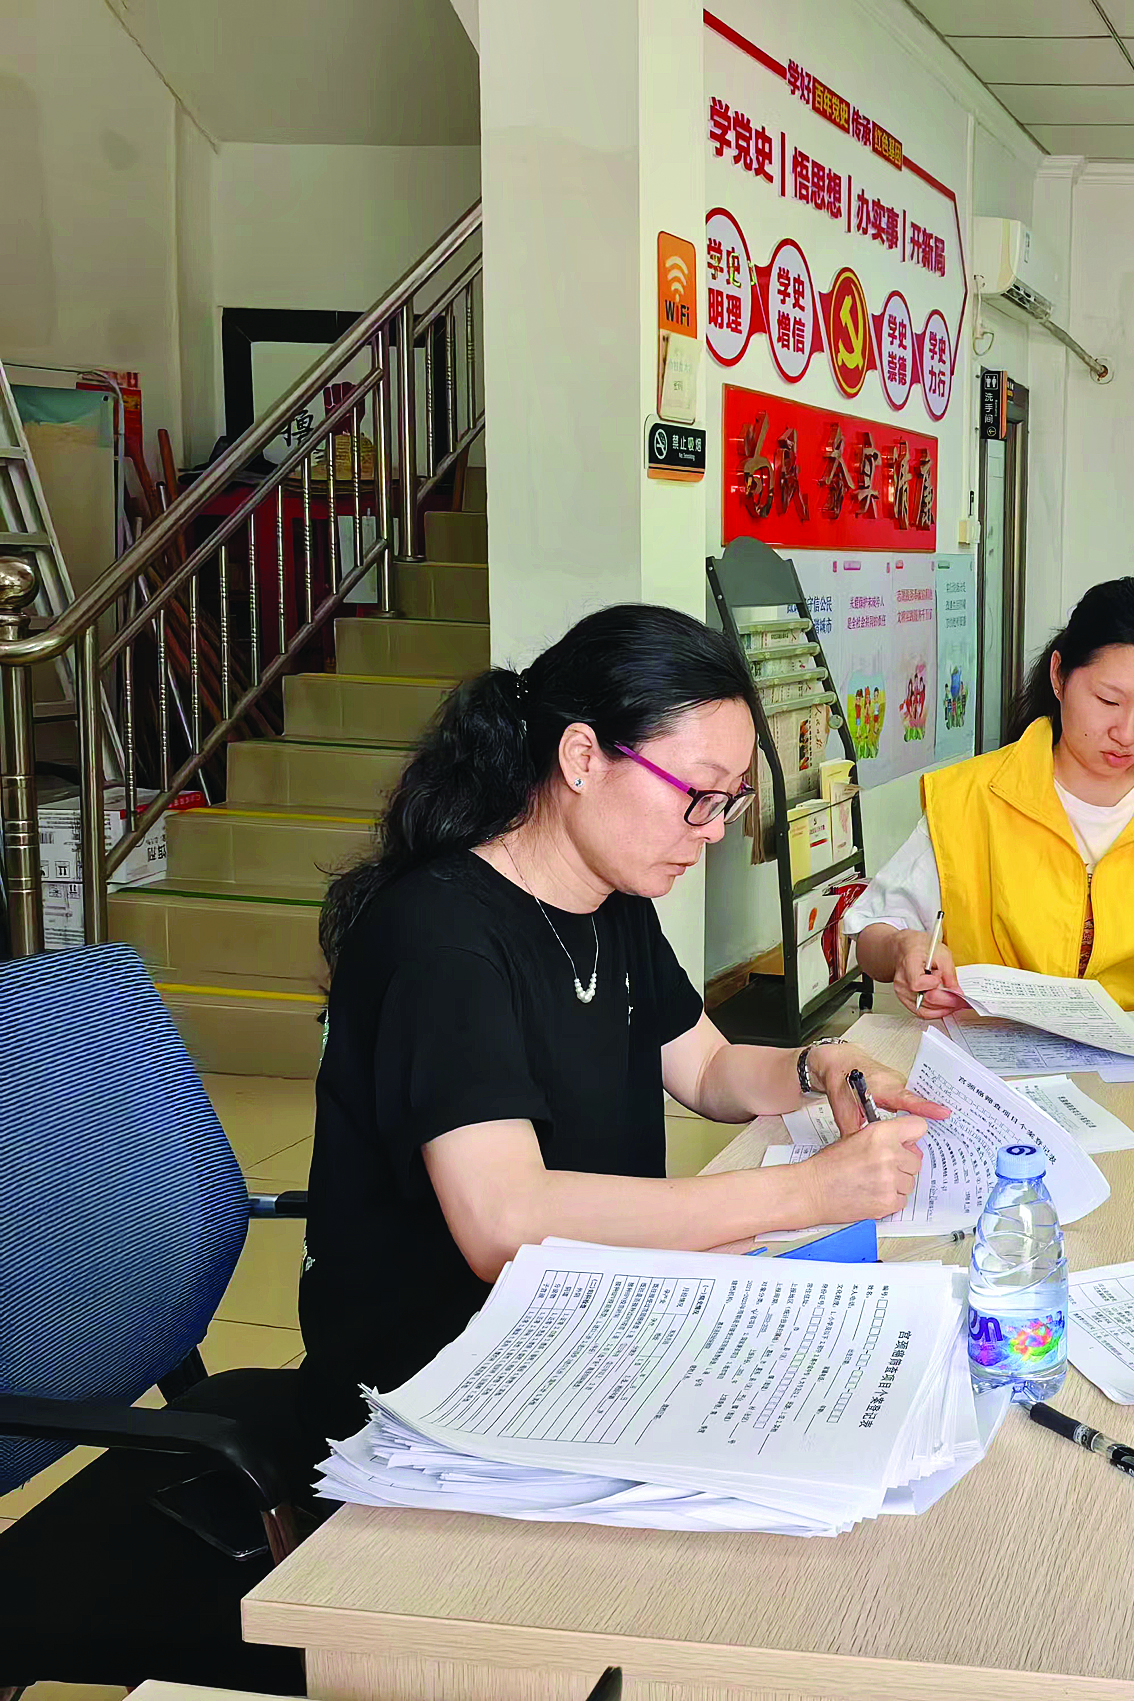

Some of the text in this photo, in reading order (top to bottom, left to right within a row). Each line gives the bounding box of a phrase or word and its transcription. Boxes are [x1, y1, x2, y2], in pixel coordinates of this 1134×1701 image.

[787, 58, 811, 104] 学好
[814, 82, 848, 128] 百年党史
[852, 106, 870, 146] 传承
[708, 97, 946, 278] 学党史 悟思想 办实事 开新局
[777, 266, 806, 312] 学史
[665, 299, 690, 327] WiFi
[708, 288, 743, 335] 明理
[777, 310, 806, 354] 增信
[887, 313, 908, 350] 学史
[928, 365, 946, 398] 力行
[984, 392, 994, 424] 洗手间
[672, 434, 702, 453] 禁止吸烟
[858, 1330, 912, 1428] 宫颈癌筛查项目个案登记表
